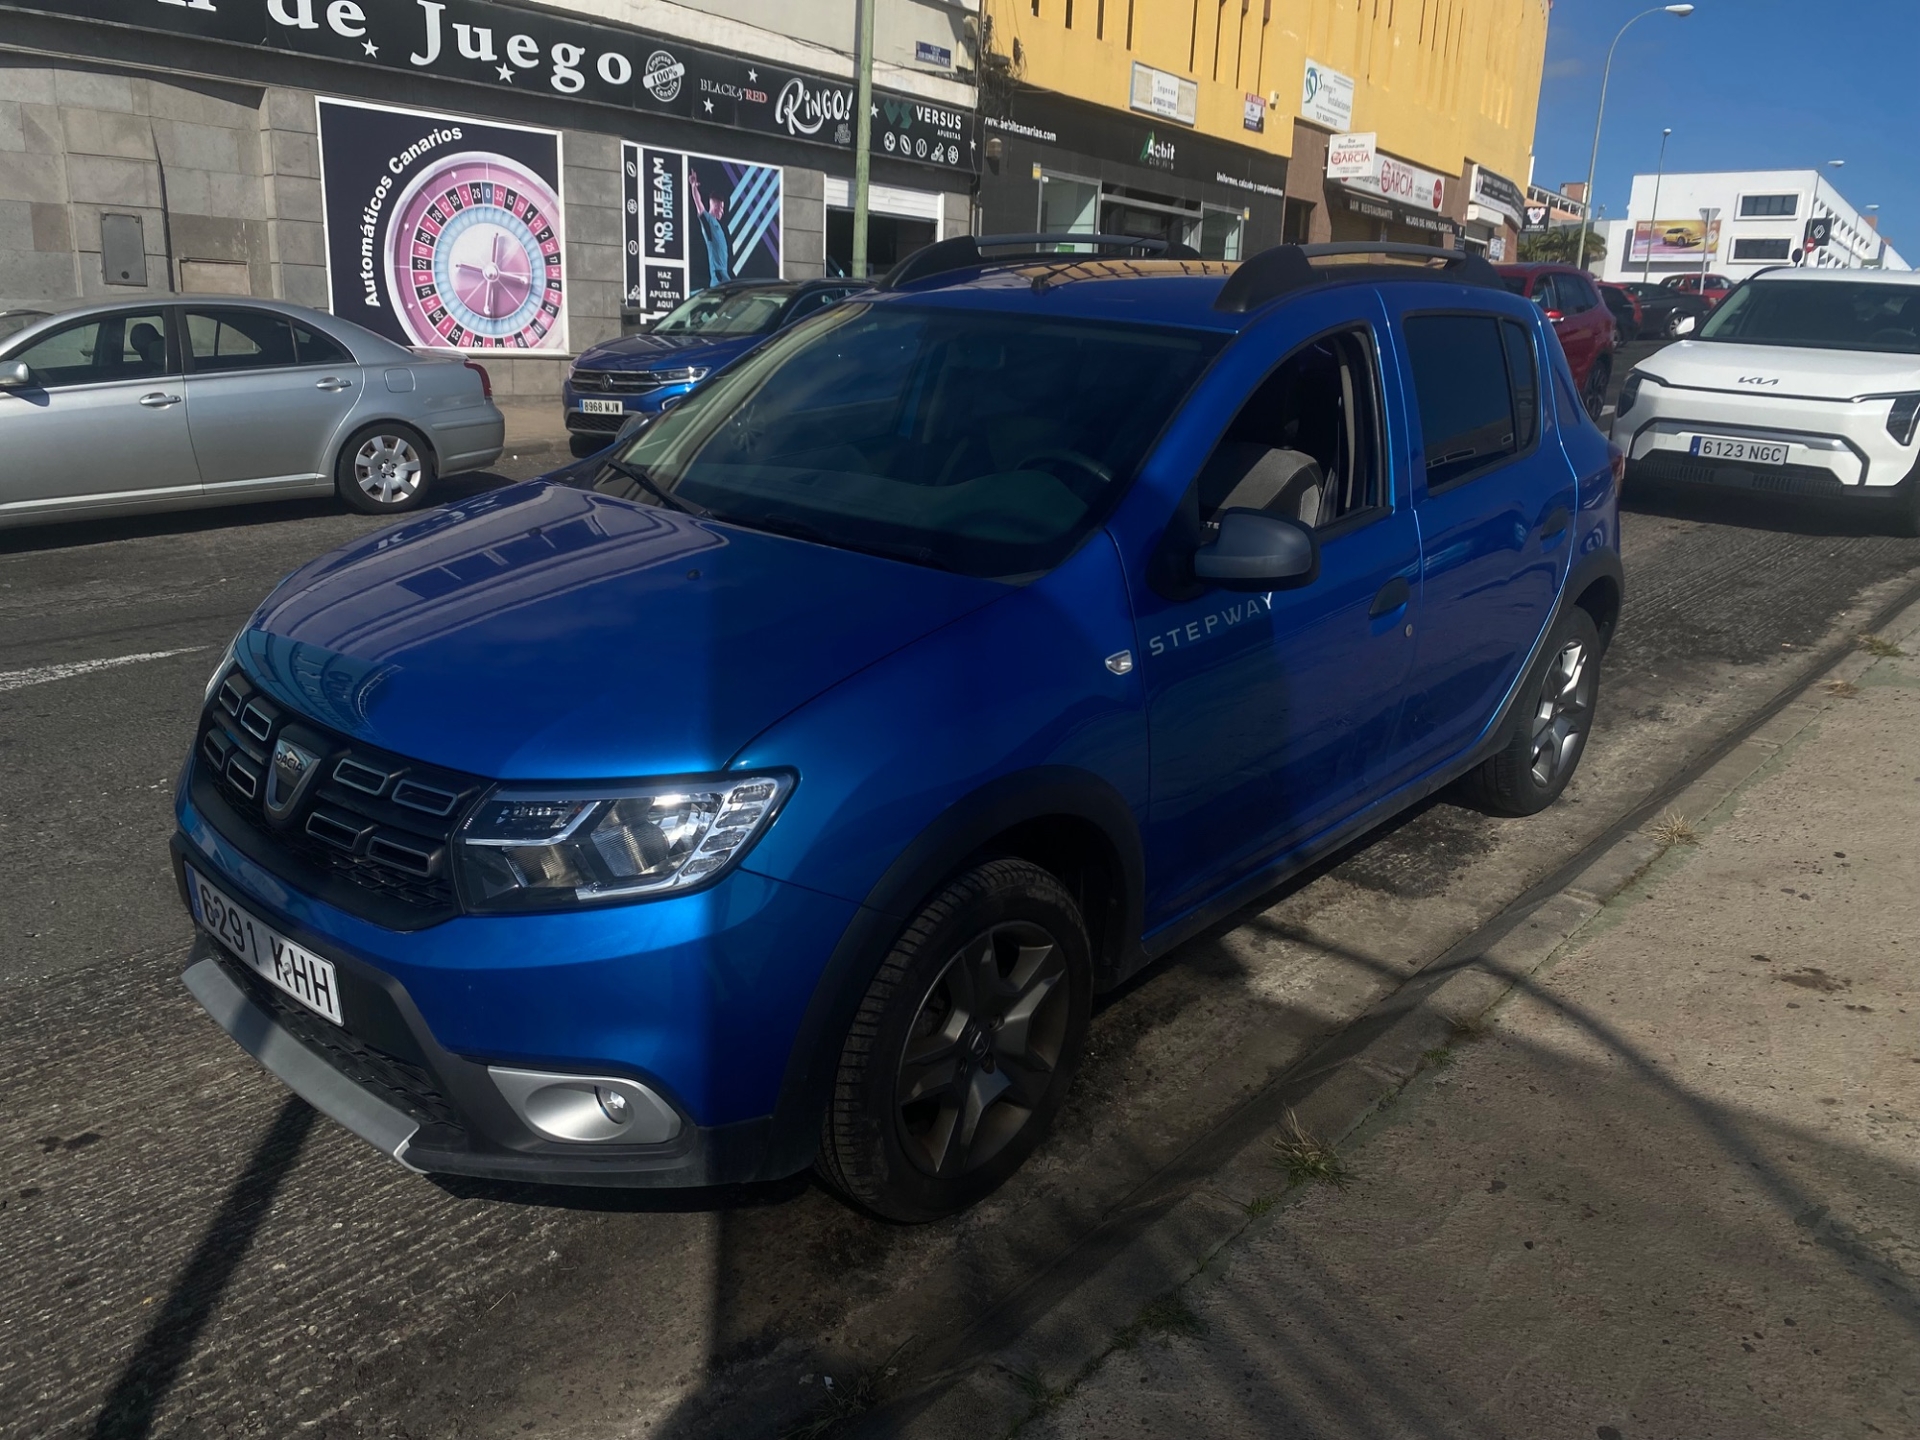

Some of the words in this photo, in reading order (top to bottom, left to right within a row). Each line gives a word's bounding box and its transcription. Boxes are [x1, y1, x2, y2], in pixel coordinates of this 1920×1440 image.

[267, 0, 366, 37] de
[410, 0, 632, 93] Juego
[652, 68, 678, 85] 100%
[915, 105, 962, 130] VERSUS
[937, 129, 961, 141] APUESTAS
[653, 157, 665, 217] TEAM
[463, 191, 469, 200] 3
[472, 188, 481, 199] 26
[486, 189, 490, 198] 0
[496, 190, 503, 201] 32
[662, 173, 673, 219] DREAM
[450, 193, 460, 206] 35
[507, 194, 514, 205] 15
[440, 201, 450, 213] 12
[1361, 202, 1394, 220] RESTAURANTE
[360, 175, 393, 307] Automáticos
[388, 127, 463, 174] Canarios
[432, 211, 443, 222] 28
[526, 210, 534, 219] 4
[425, 222, 435, 231] 7
[533, 220, 543, 230] 21
[540, 231, 549, 239] 2
[654, 221, 666, 253] NO
[663, 222, 674, 241] NO
[421, 233, 431, 244] 29
[545, 242, 555, 253] 25
[417, 260, 427, 269] 22
[549, 256, 558, 264] 17
[551, 268, 560, 278] 34
[657, 271, 672, 279] HAZ
[659, 281, 670, 289] TU
[421, 287, 431, 296] 31
[649, 290, 680, 300] APUESTA
[656, 299, 674, 309] AQUÍ
[432, 310, 444, 322] 20
[451, 328, 462, 341] 33
[533, 324, 543, 334] 11
[517, 337, 525, 347] 8
[1737, 376, 1779, 386] KIA
[584, 401, 602, 412] 8968
[604, 403, 620, 413] MJW
[1703, 440, 1744, 458] 6123
[1748, 445, 1782, 462] NGC
[1149, 591, 1273, 656] STEPWAY
[275, 751, 302, 772] DACIA
[200, 884, 260, 966] 6291
[270, 936, 333, 1014] KHH
